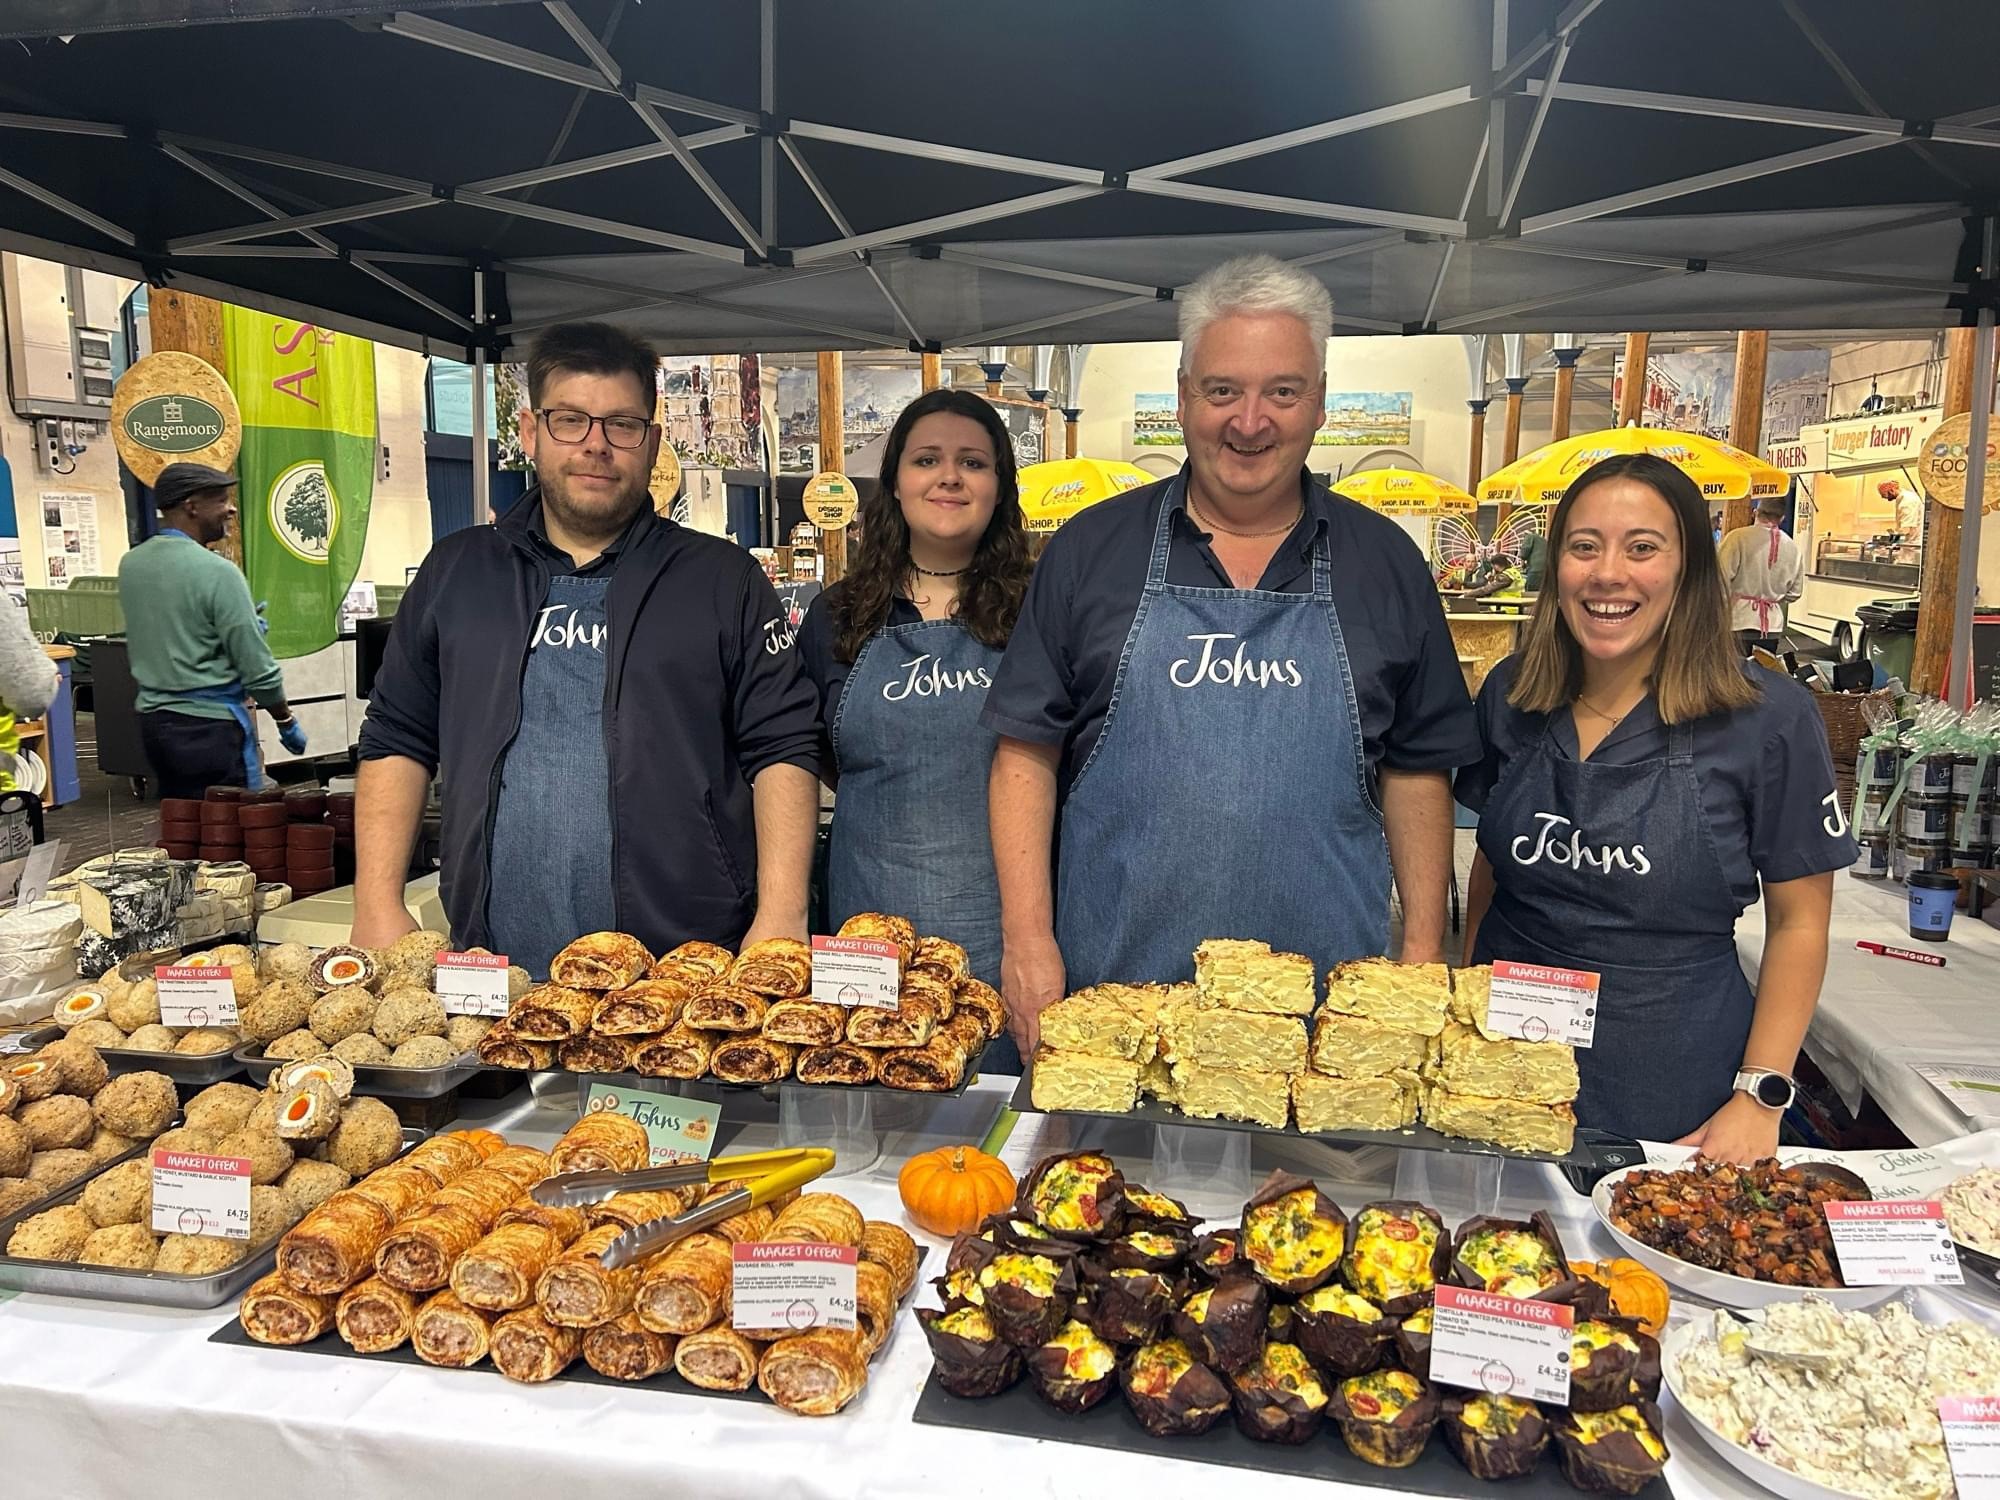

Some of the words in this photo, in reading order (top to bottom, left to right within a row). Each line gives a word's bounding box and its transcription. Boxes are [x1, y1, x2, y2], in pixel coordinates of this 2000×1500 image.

[132, 421, 218, 441] Rangemoors
[1832, 429, 1869, 455] burger
[1869, 424, 1914, 450] factory
[1931, 458, 1968, 473] FOO
[1703, 483, 1727, 494] BUY.
[1029, 518, 1054, 529] SHOP.
[530, 604, 607, 649] John
[1169, 633, 1303, 689] Johns
[882, 653, 993, 701] Johns
[1511, 812, 1651, 876] Johns
[825, 939, 862, 949] MARKET
[862, 942, 889, 954] OFFER!
[446, 954, 477, 964] MARKET
[478, 956, 500, 966] OFFER!
[166, 968, 196, 977] MARKET
[197, 968, 222, 977] OFFER!
[1508, 966, 1553, 980] MARKET
[1553, 972, 1586, 985] OFFER!
[879, 983, 897, 993] £4.25
[218, 1003, 236, 1011] £4.75
[1569, 1018, 1593, 1028] £4.25
[623, 1100, 681, 1131] Johns
[651, 1146, 677, 1160] FOR
[167, 1154, 205, 1169] MARKET
[208, 1158, 239, 1171] OFFER!
[1874, 1151, 1936, 1172] Johns
[227, 1208, 249, 1218] £4.75
[1843, 1204, 1889, 1216] MARKET
[1892, 1204, 1928, 1215] OFFER!
[752, 1245, 801, 1258] MARKET
[804, 1246, 842, 1259] OFFER!
[1929, 1253, 1956, 1264] £4.50
[829, 1297, 854, 1308] £4.25
[1455, 1292, 1511, 1311] MARKET
[1512, 1302, 1555, 1320] OFFER!
[1435, 1314, 1459, 1324] TOMATO
[1436, 1307, 1463, 1317] TORTILLA
[1467, 1312, 1490, 1322] MINTED
[1526, 1322, 1547, 1331] ROAST
[1537, 1364, 1567, 1379] £4.25
[1962, 1401, 2000, 1417] MAR
